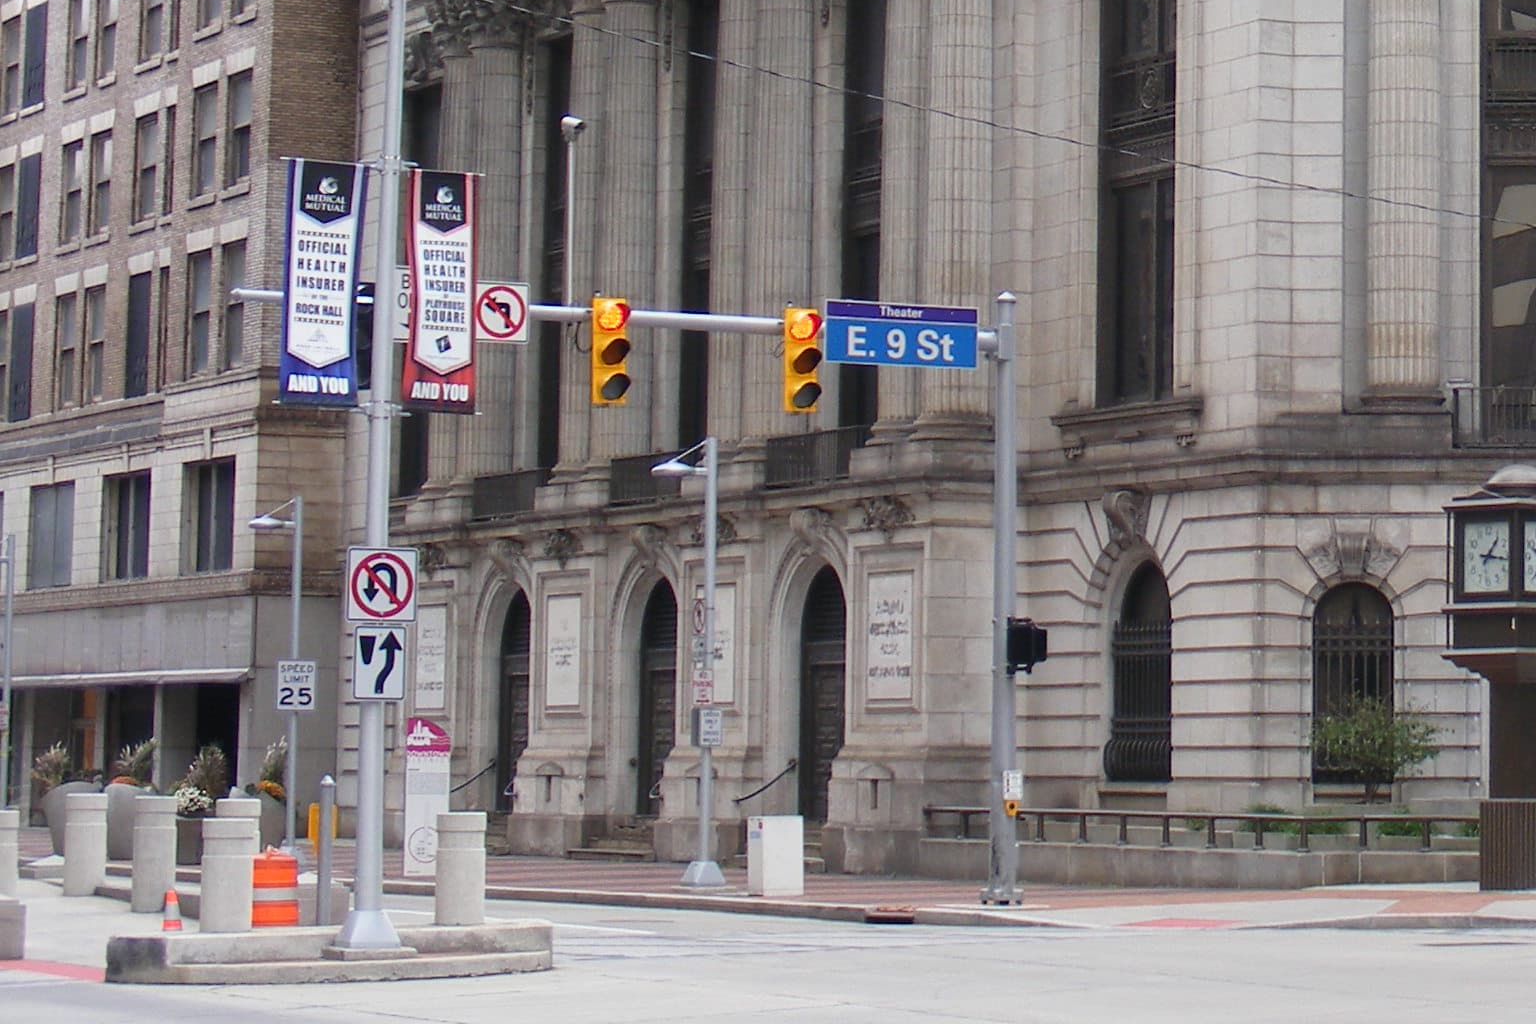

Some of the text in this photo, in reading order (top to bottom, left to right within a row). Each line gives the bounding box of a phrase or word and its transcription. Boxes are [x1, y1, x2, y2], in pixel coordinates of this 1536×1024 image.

[305, 193, 346, 204] MEDICAL
[305, 203, 346, 213] MUTUAL
[425, 203, 462, 213] MEDICAL
[425, 212, 462, 221] MUTUAL
[298, 239, 348, 256] OFFICIAL
[423, 249, 465, 263] OFFICIAL
[297, 258, 346, 273] HEALTH
[424, 265, 466, 278] HEALTH
[296, 275, 345, 291] INSURER
[425, 279, 465, 293] INSURER
[295, 302, 343, 317] ROCK HALL
[425, 299, 465, 311] PLAYHOUSE
[880, 306, 923, 318] Theater
[425, 309, 465, 324] SQUARE
[847, 326, 955, 362] E. 9 St
[288, 374, 349, 395] AND YOU
[411, 381, 469, 402] AND YOU
[280, 664, 314, 673] SPEED
[283, 675, 309, 684] LIMIT
[280, 687, 312, 706] 25
